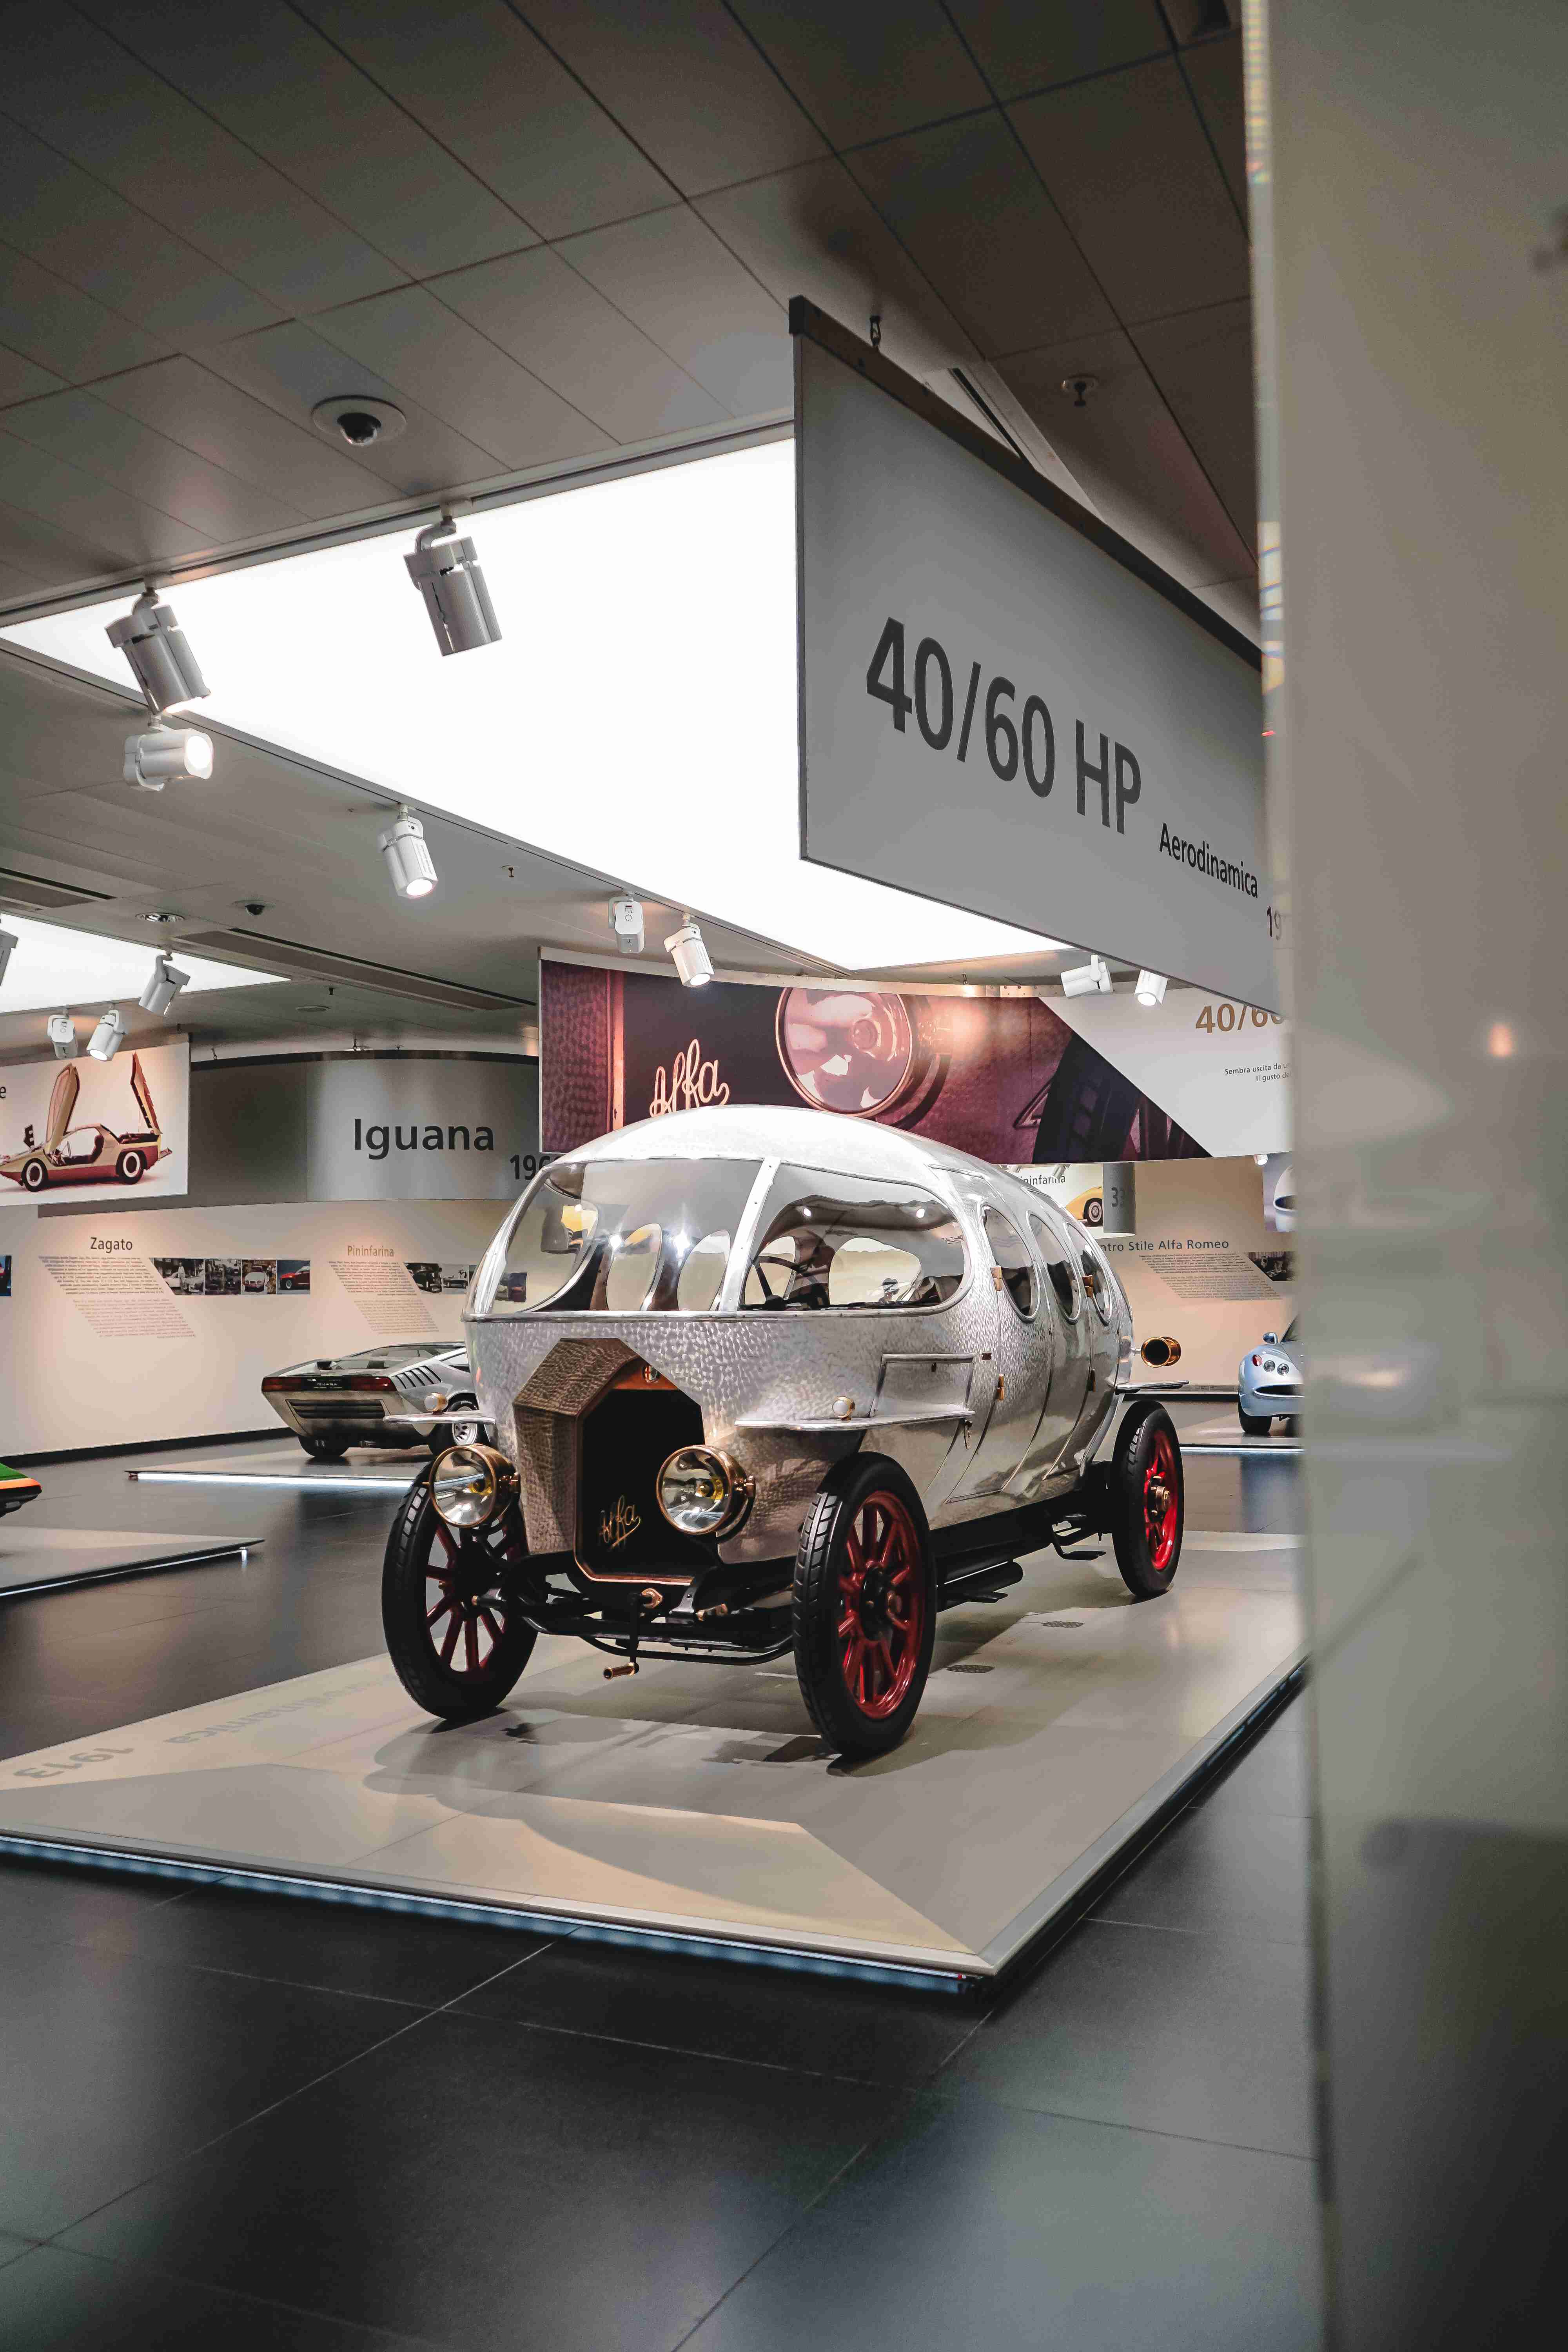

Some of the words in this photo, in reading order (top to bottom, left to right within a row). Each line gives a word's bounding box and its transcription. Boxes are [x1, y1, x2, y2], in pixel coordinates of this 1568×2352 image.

[866, 617, 1055, 798] 40/60
[1075, 719, 1141, 835] HP
[1159, 822, 1258, 898] Aerodinamica
[1252, 1064, 1271, 1072] uscita
[1262, 1073, 1280, 1082] gusto
[354, 1118, 494, 1160] Iguana
[510, 1154, 561, 1180] 19
[1020, 1175, 1065, 1185] ninfarina
[90, 1237, 133, 1254] Zagato
[347, 1245, 394, 1257] Pininfarina
[1100, 1242, 1124, 1251] ntro
[1129, 1240, 1154, 1251] Stile
[1158, 1240, 1183, 1250] Alfa
[1187, 1240, 1229, 1249] Romeo
